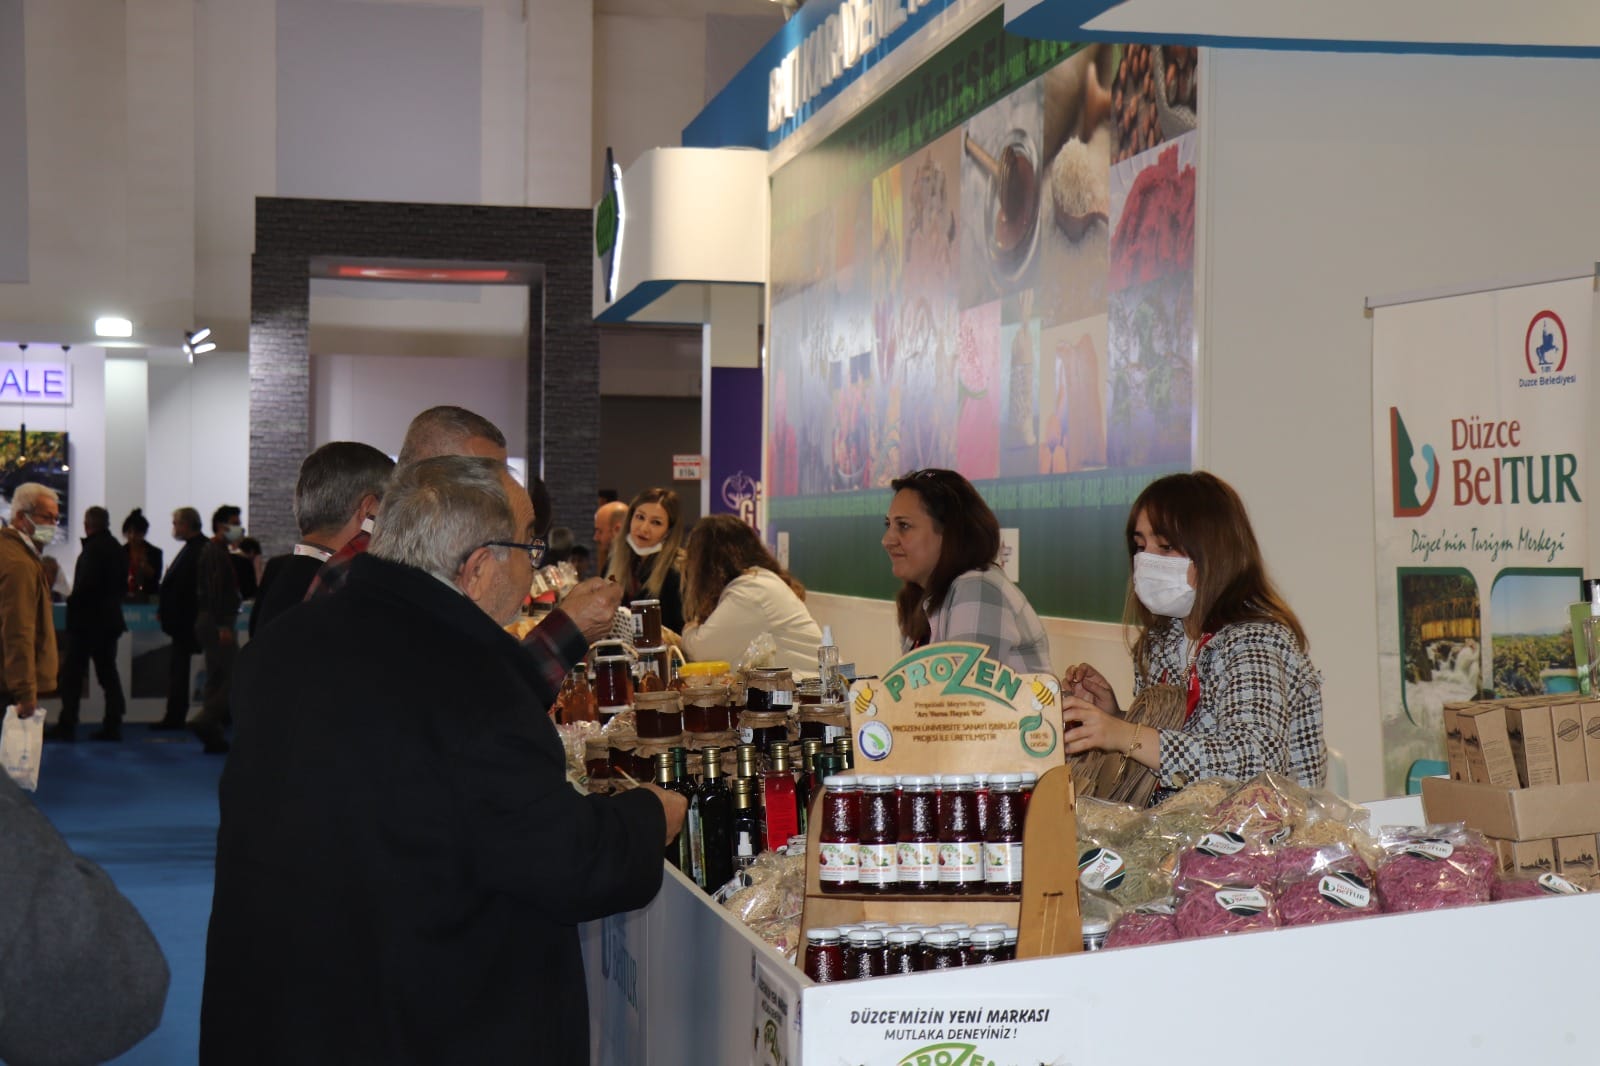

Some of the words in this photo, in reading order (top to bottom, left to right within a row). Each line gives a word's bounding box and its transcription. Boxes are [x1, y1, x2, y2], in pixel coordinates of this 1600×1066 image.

[1539, 374, 1577, 386] Belediyesi
[1451, 415, 1521, 451] Düzce
[1452, 453, 1583, 506] BelTUR
[1471, 527, 1514, 562] Turizm
[1518, 526, 1566, 562] Merkezi
[882, 645, 1023, 708] PROZEN
[850, 1007, 945, 1024] DÜZCE'MİZİN
[949, 1006, 984, 1024] YENİ
[986, 1008, 1050, 1024] MARKASI
[884, 1029, 945, 1041] MUTLAKA
[947, 1024, 1011, 1040] DENEYİNİZ
[898, 1042, 996, 1066] ROZE
